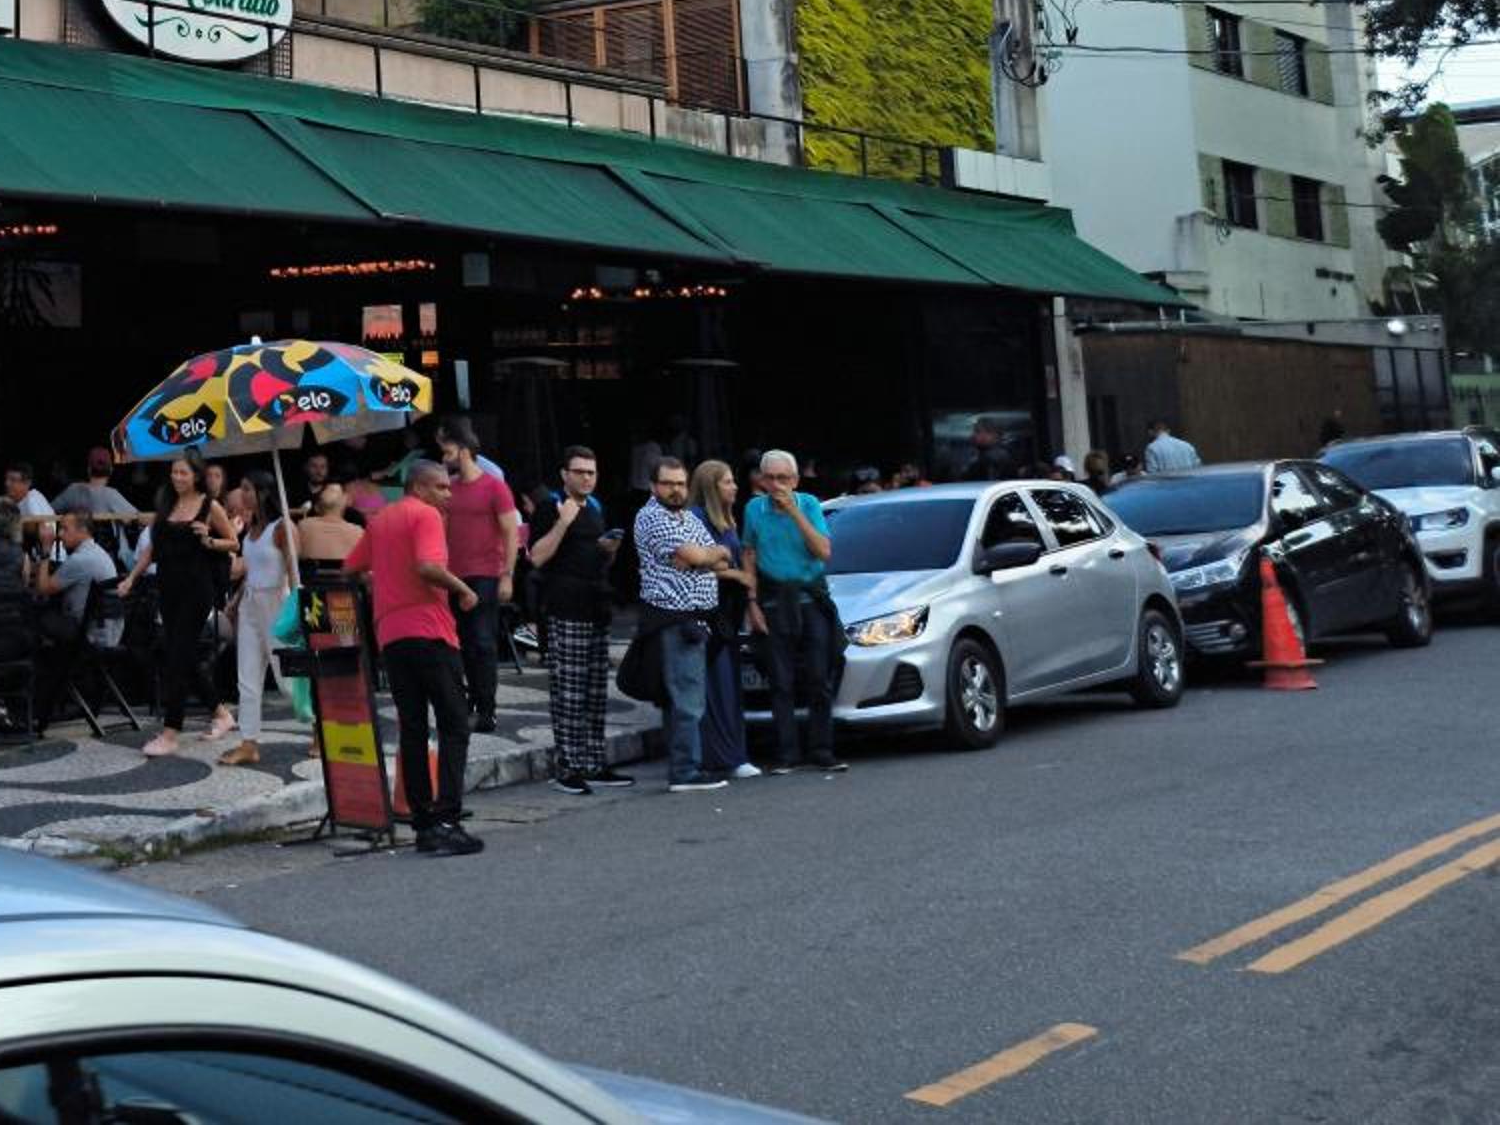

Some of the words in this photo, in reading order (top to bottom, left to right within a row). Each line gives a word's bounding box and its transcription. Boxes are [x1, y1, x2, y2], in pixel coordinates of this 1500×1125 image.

[297, 390, 331, 411] elo
[390, 383, 411, 403] elo
[180, 417, 207, 437] elo
